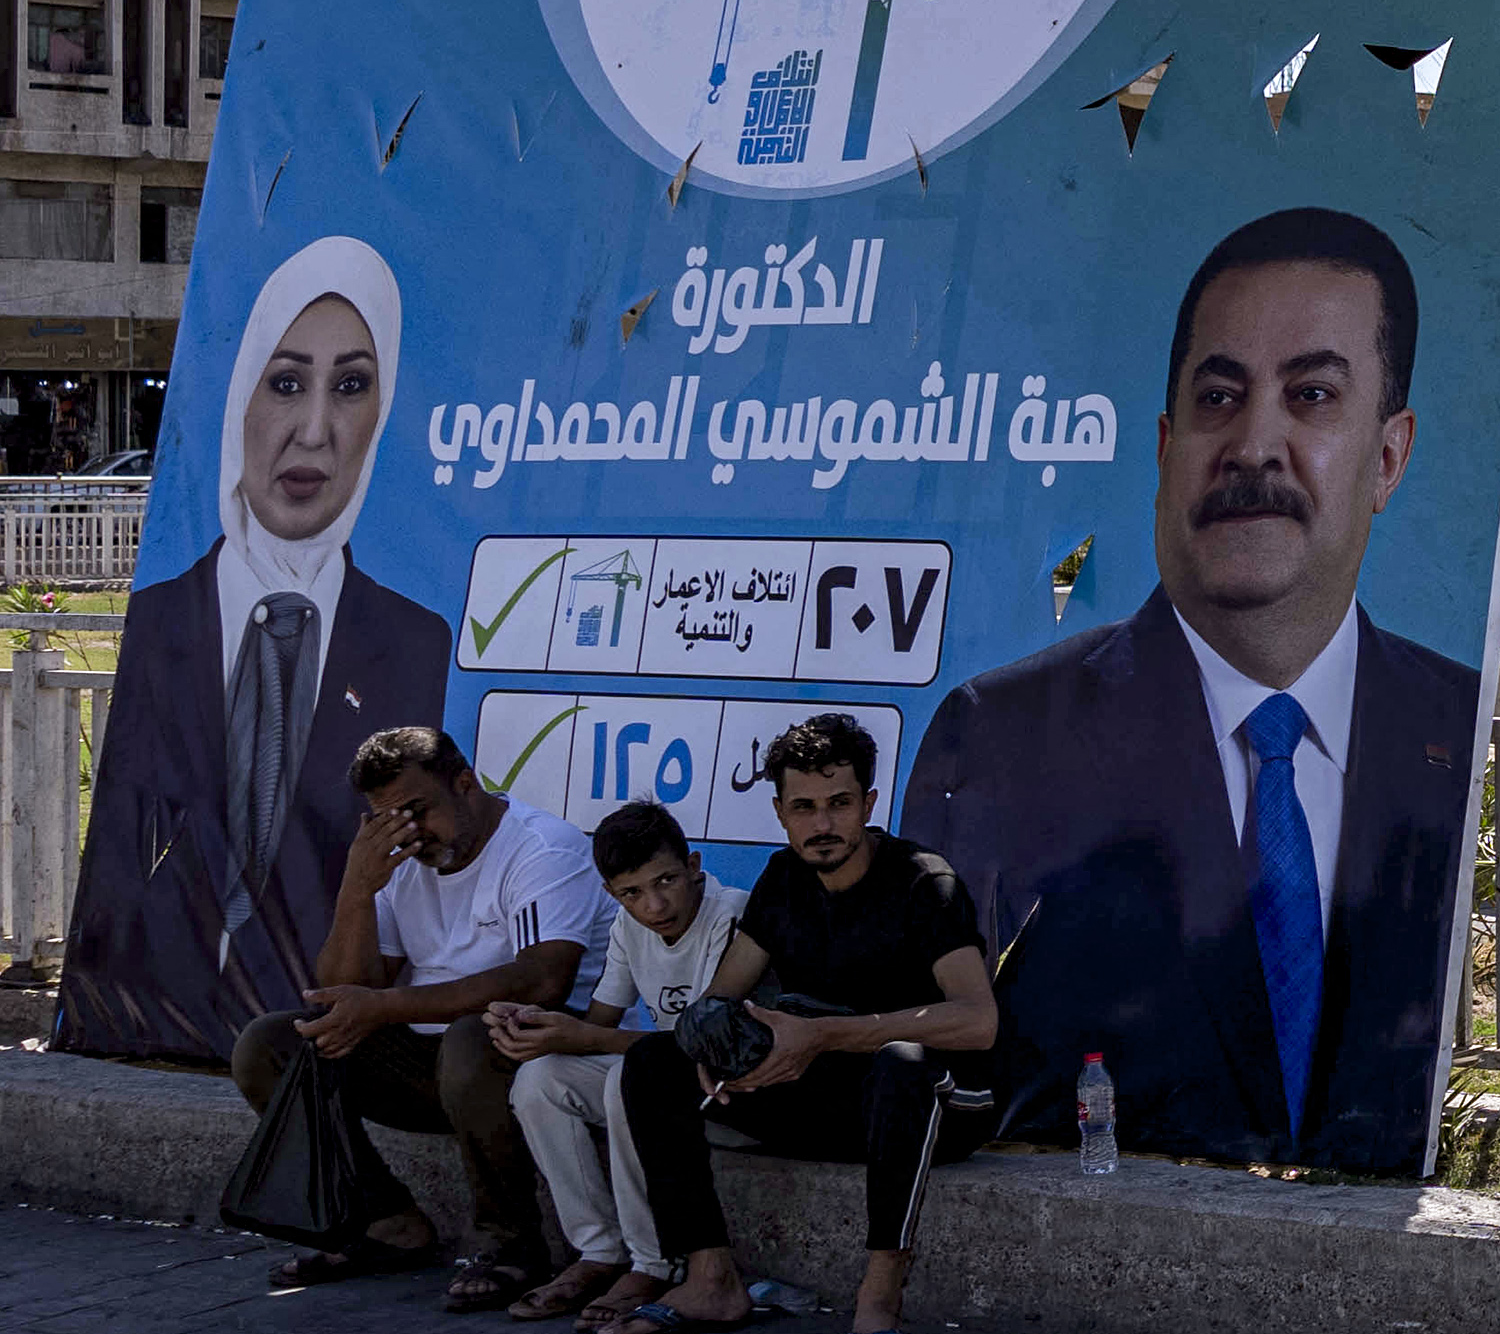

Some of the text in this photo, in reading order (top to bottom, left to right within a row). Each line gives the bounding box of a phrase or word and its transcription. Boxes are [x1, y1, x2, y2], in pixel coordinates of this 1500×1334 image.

[672, 236, 884, 354] الدكتورة
[428, 361, 1116, 489] هبة الشموسي المحمداوي
[653, 568, 796, 609] ائتلاف الاعمار
[675, 602, 754, 652] والتنمية
[816, 566, 941, 653] ٢٠٧
[591, 721, 692, 804] ١٢٥
